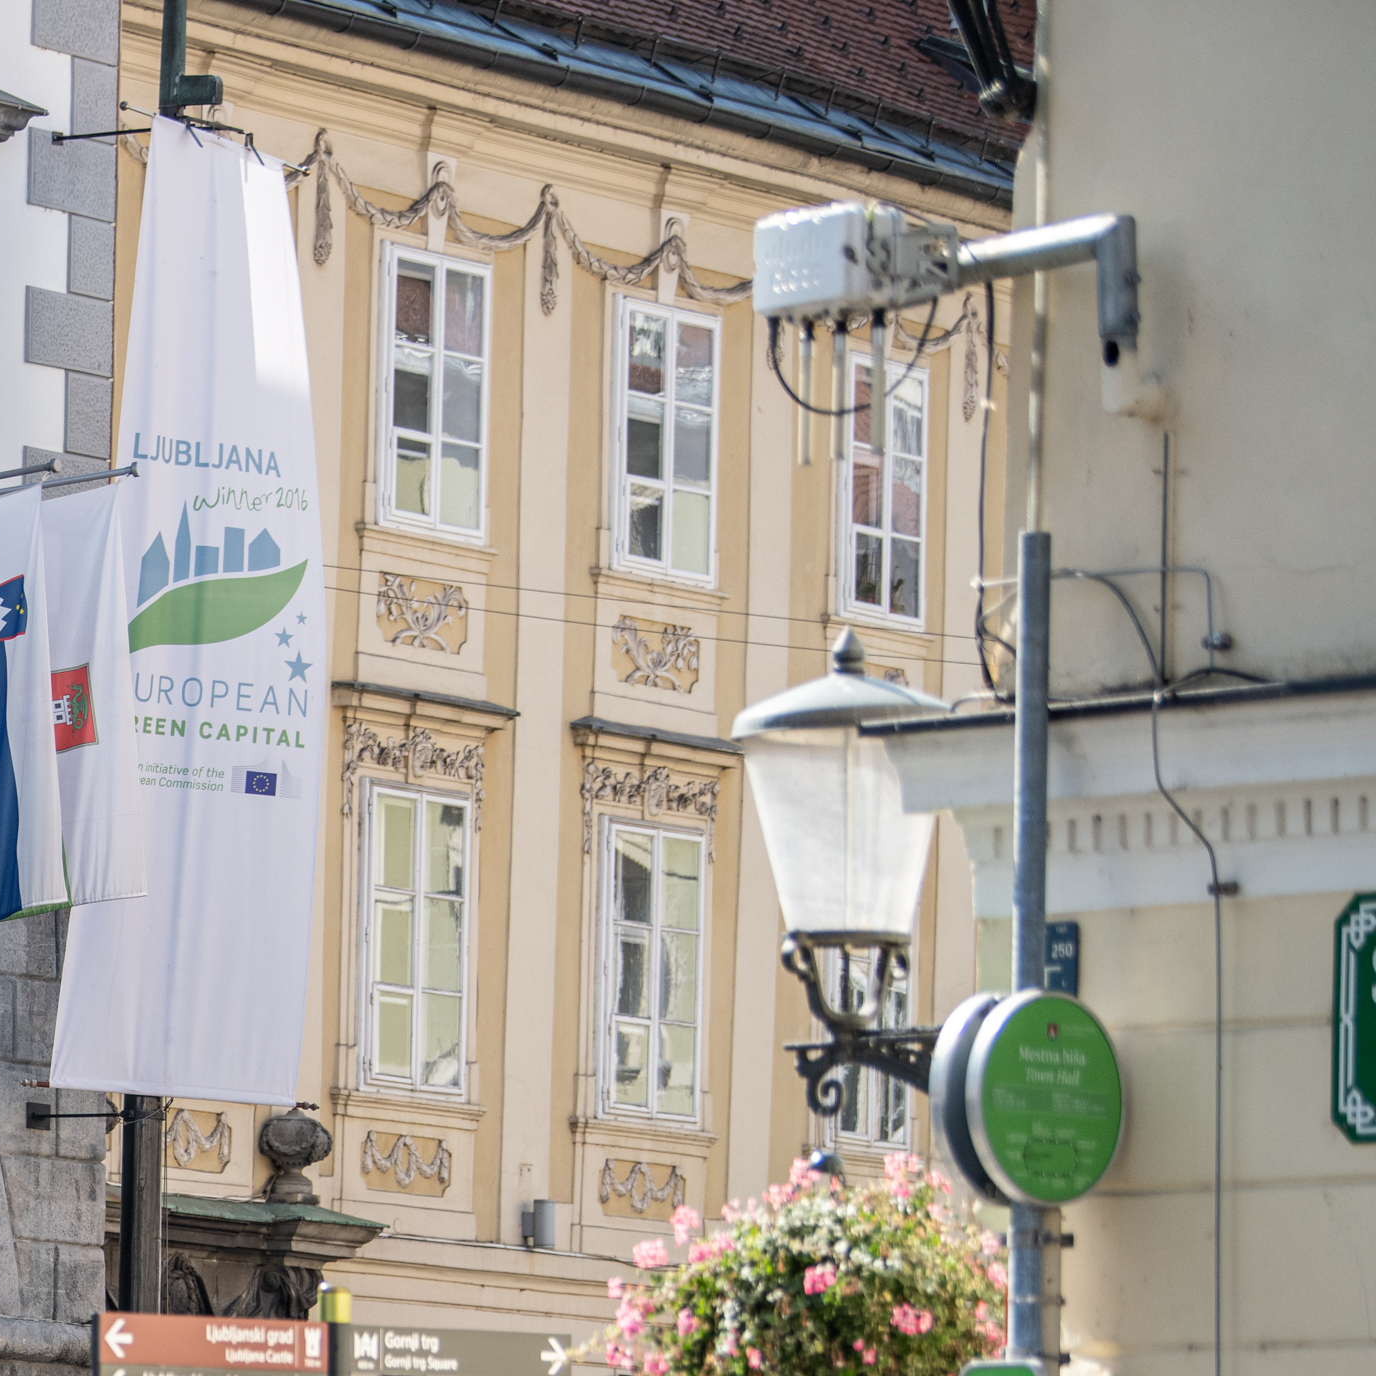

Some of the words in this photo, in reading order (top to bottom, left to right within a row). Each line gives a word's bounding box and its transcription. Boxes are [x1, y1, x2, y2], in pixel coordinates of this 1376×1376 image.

[133, 432, 281, 478] LJUBLJANA
[193, 486, 273, 511] winner
[276, 486, 308, 511] 2016
[134, 672, 308, 718] UROPEAN
[134, 716, 186, 738] EEN
[199, 721, 305, 749] CAPITAL
[145, 762, 189, 776] initiative
[192, 767, 204, 779] of
[206, 767, 225, 779] the
[159, 777, 224, 792] Commission
[206, 1323, 265, 1345] Ljubljanski
[266, 1326, 294, 1346] grad
[384, 1331, 420, 1352] Gornji
[421, 1334, 440, 1353] trg
[225, 1347, 265, 1364] Ljubljana
[266, 1349, 294, 1365] Castle
[384, 1353, 412, 1371] Gornji
[413, 1356, 427, 1371] trg
[427, 1356, 458, 1372] Square
